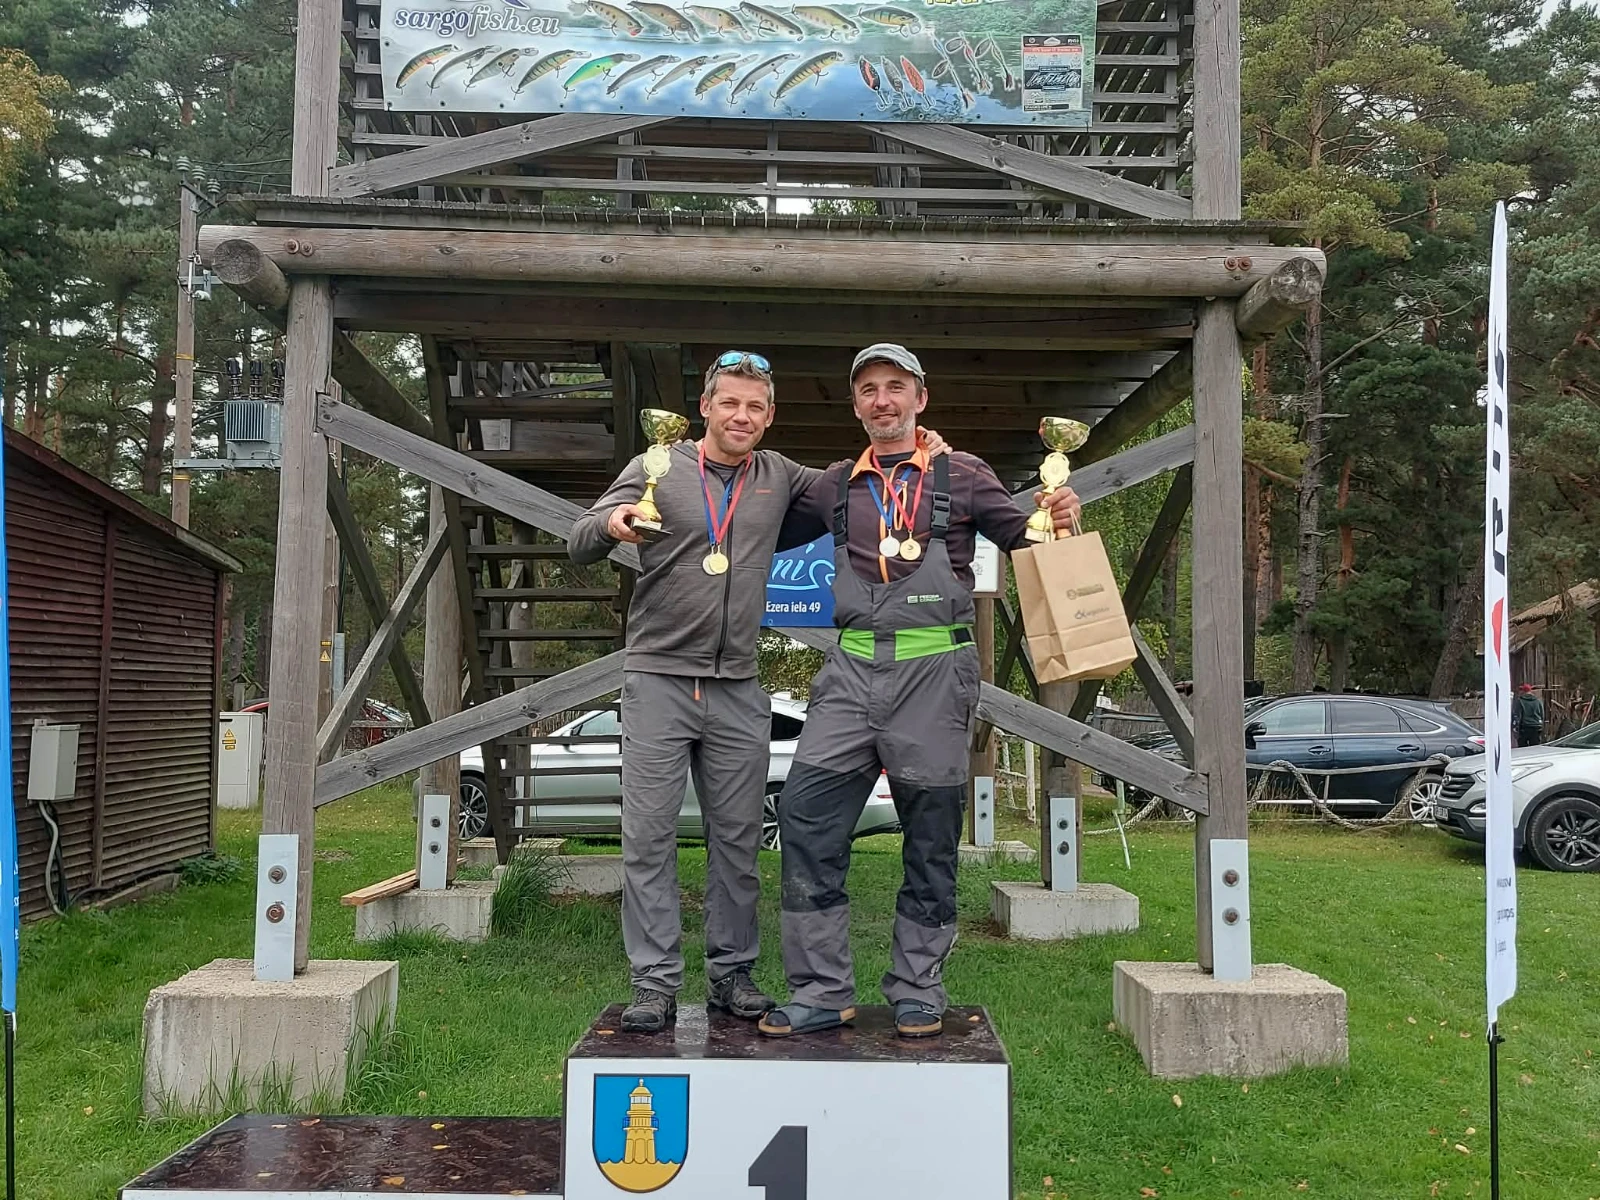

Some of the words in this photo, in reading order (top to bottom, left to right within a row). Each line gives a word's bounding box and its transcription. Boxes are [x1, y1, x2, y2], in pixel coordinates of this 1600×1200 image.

[395, 5, 560, 36] sargofish.eu
[765, 600, 790, 613] Ezera
[791, 601, 808, 613] iela
[808, 601, 822, 613] 49
[747, 1124, 808, 1200] 1
